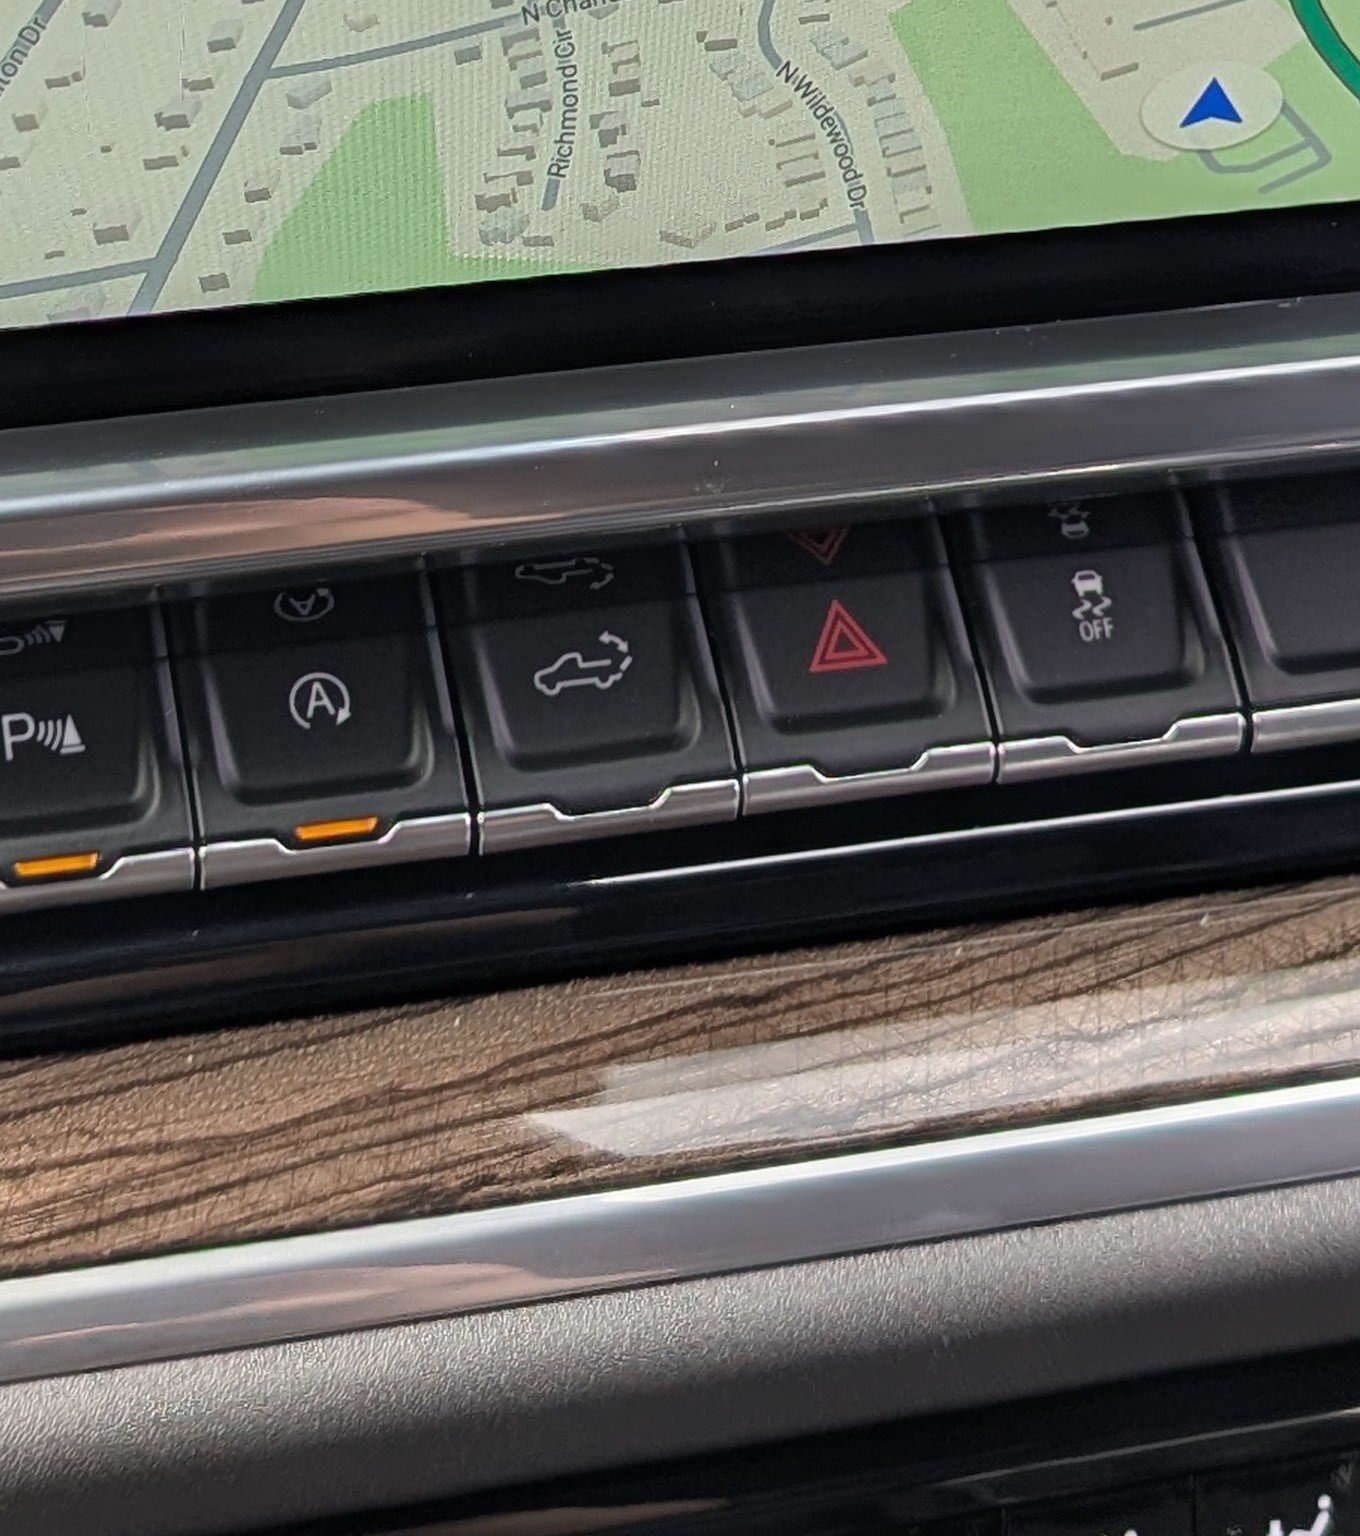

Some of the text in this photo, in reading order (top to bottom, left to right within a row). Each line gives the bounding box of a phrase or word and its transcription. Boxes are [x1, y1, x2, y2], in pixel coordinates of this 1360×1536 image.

[15, 14, 47, 48] Dr
[521, 3, 539, 25] N
[548, 28, 578, 180] Richmond Cir
[776, 60, 868, 210] N Wildewood Dr
[1079, 617, 1113, 641] OFF
